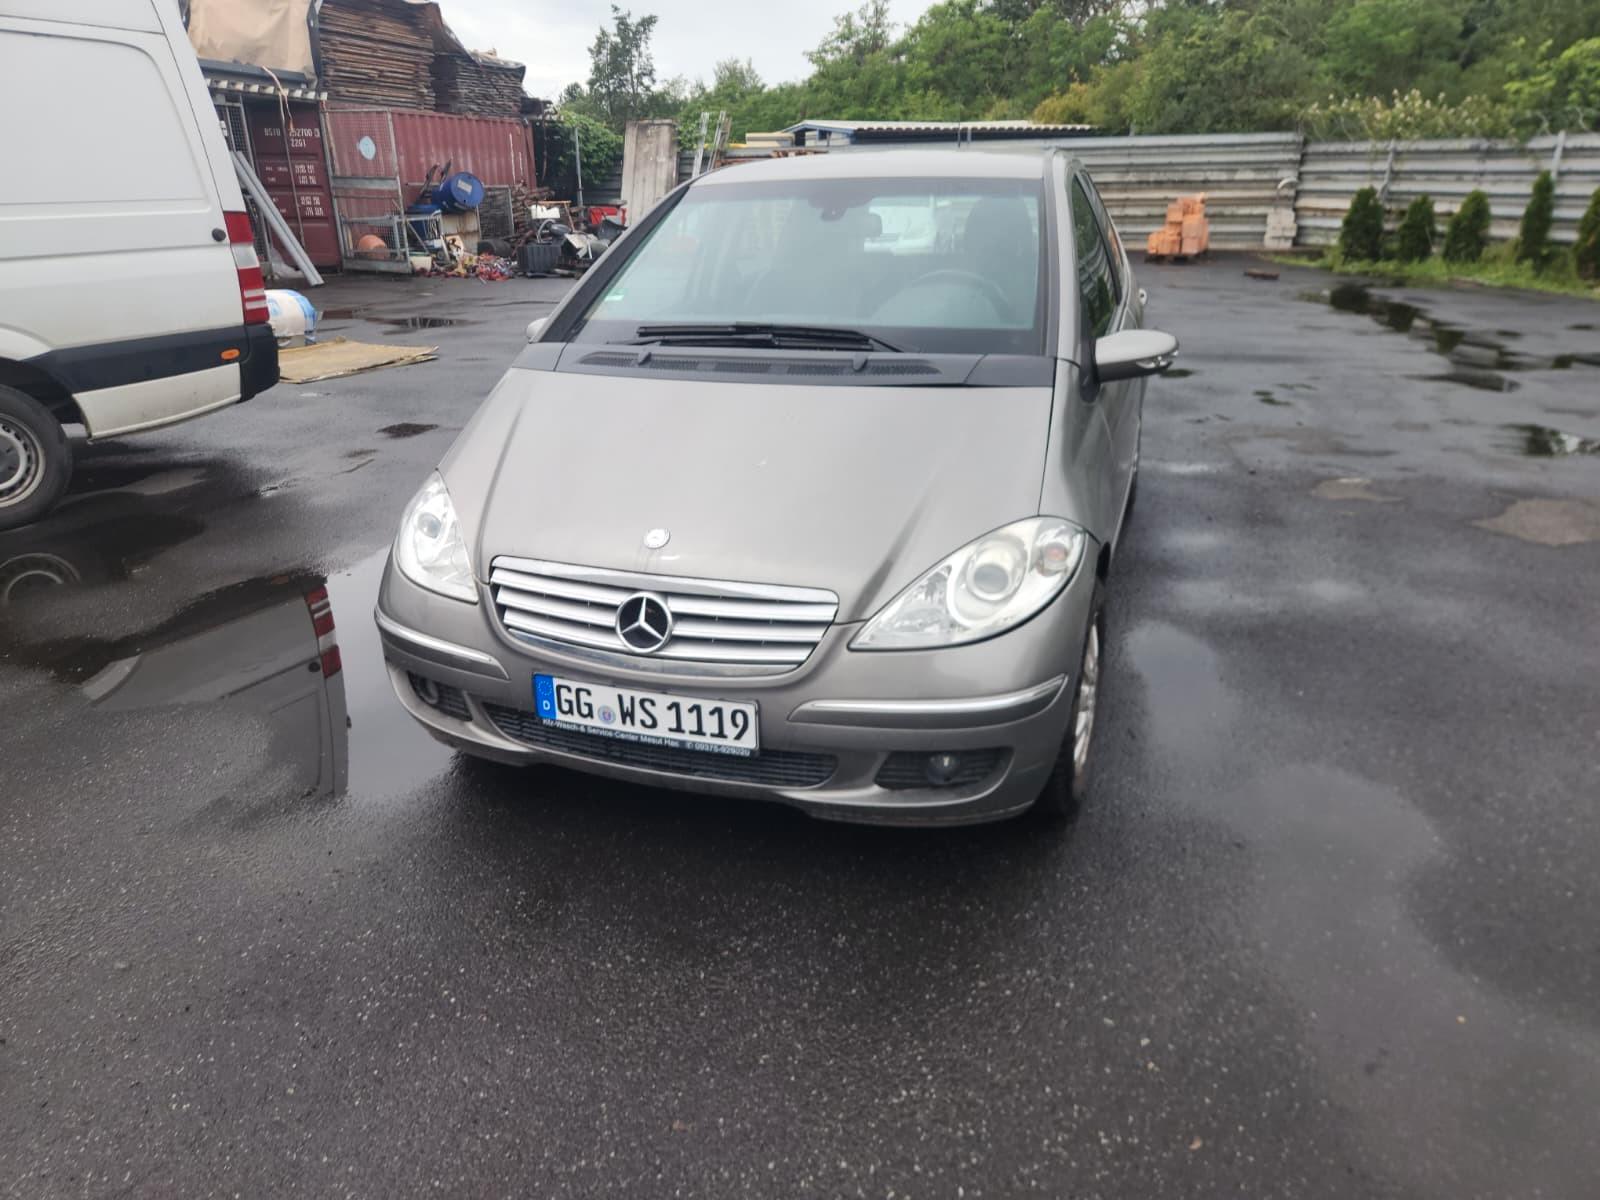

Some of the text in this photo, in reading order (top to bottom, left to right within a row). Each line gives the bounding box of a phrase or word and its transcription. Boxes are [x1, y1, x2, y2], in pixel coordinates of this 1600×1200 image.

[542, 700, 551, 711] D
[556, 684, 749, 741] GG WS 1119
